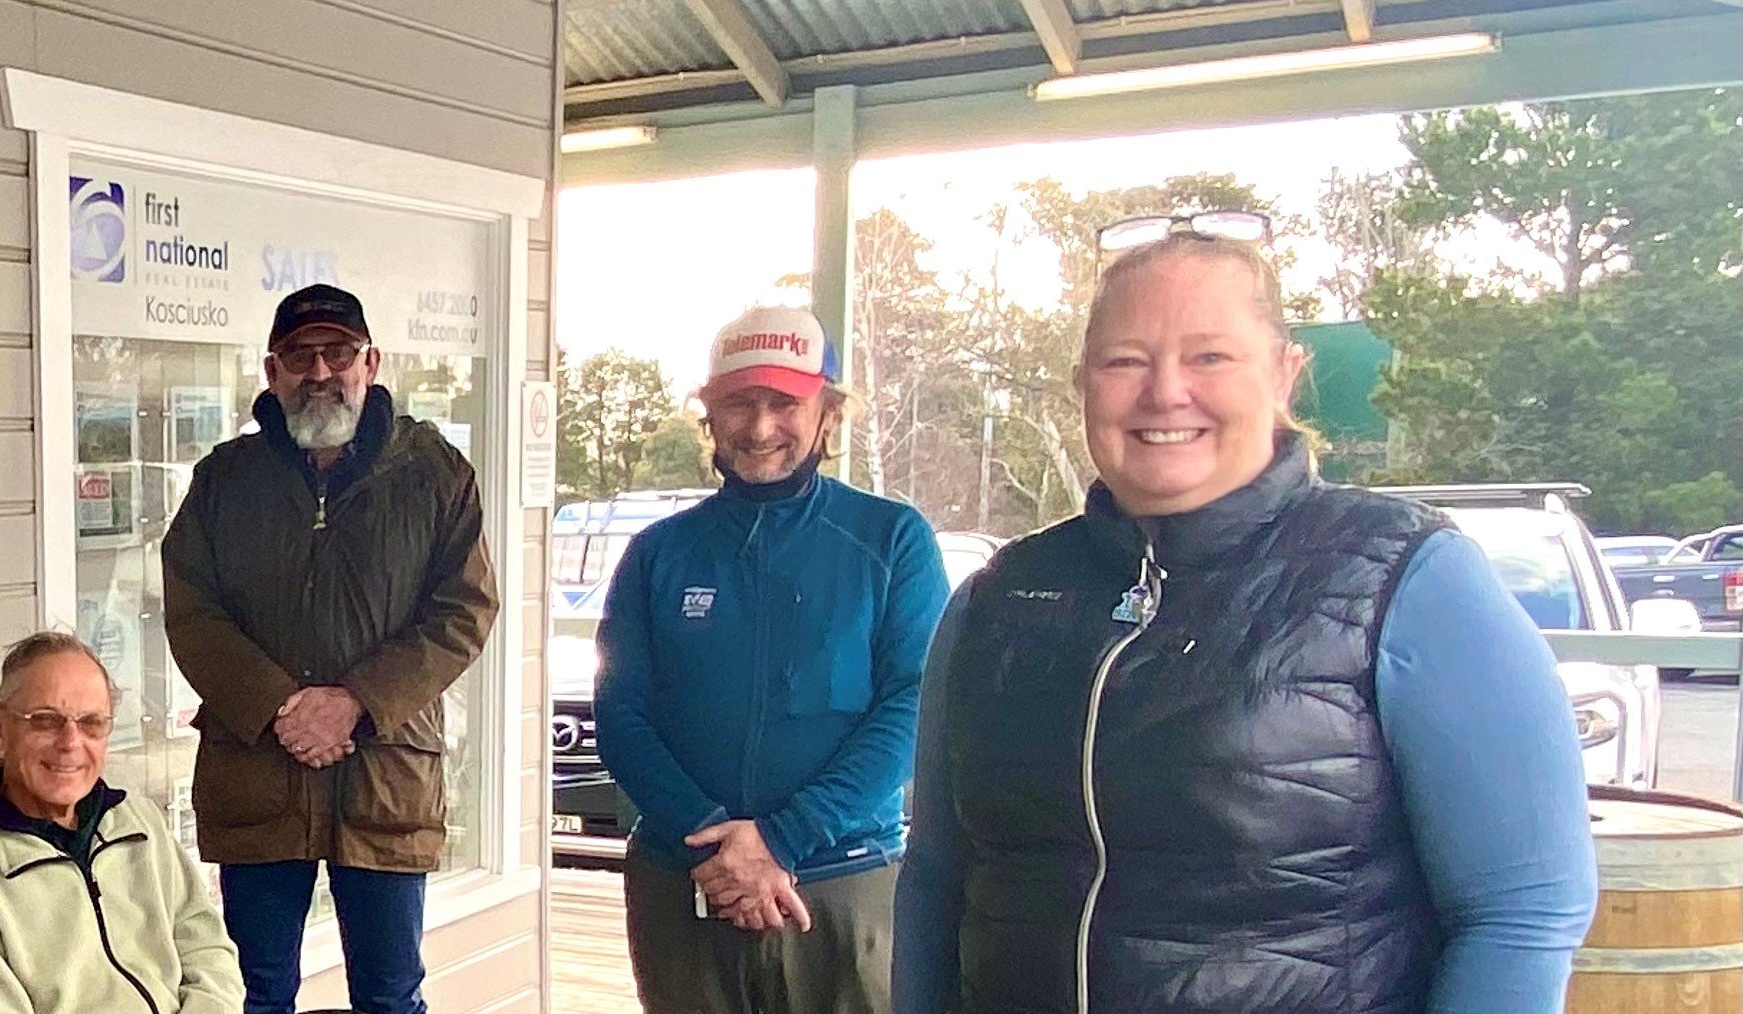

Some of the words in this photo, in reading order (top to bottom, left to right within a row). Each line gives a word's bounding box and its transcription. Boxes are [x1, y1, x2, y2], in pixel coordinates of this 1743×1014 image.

[145, 192, 180, 227] first
[145, 235, 229, 271] national
[145, 295, 229, 327] Kosciusko
